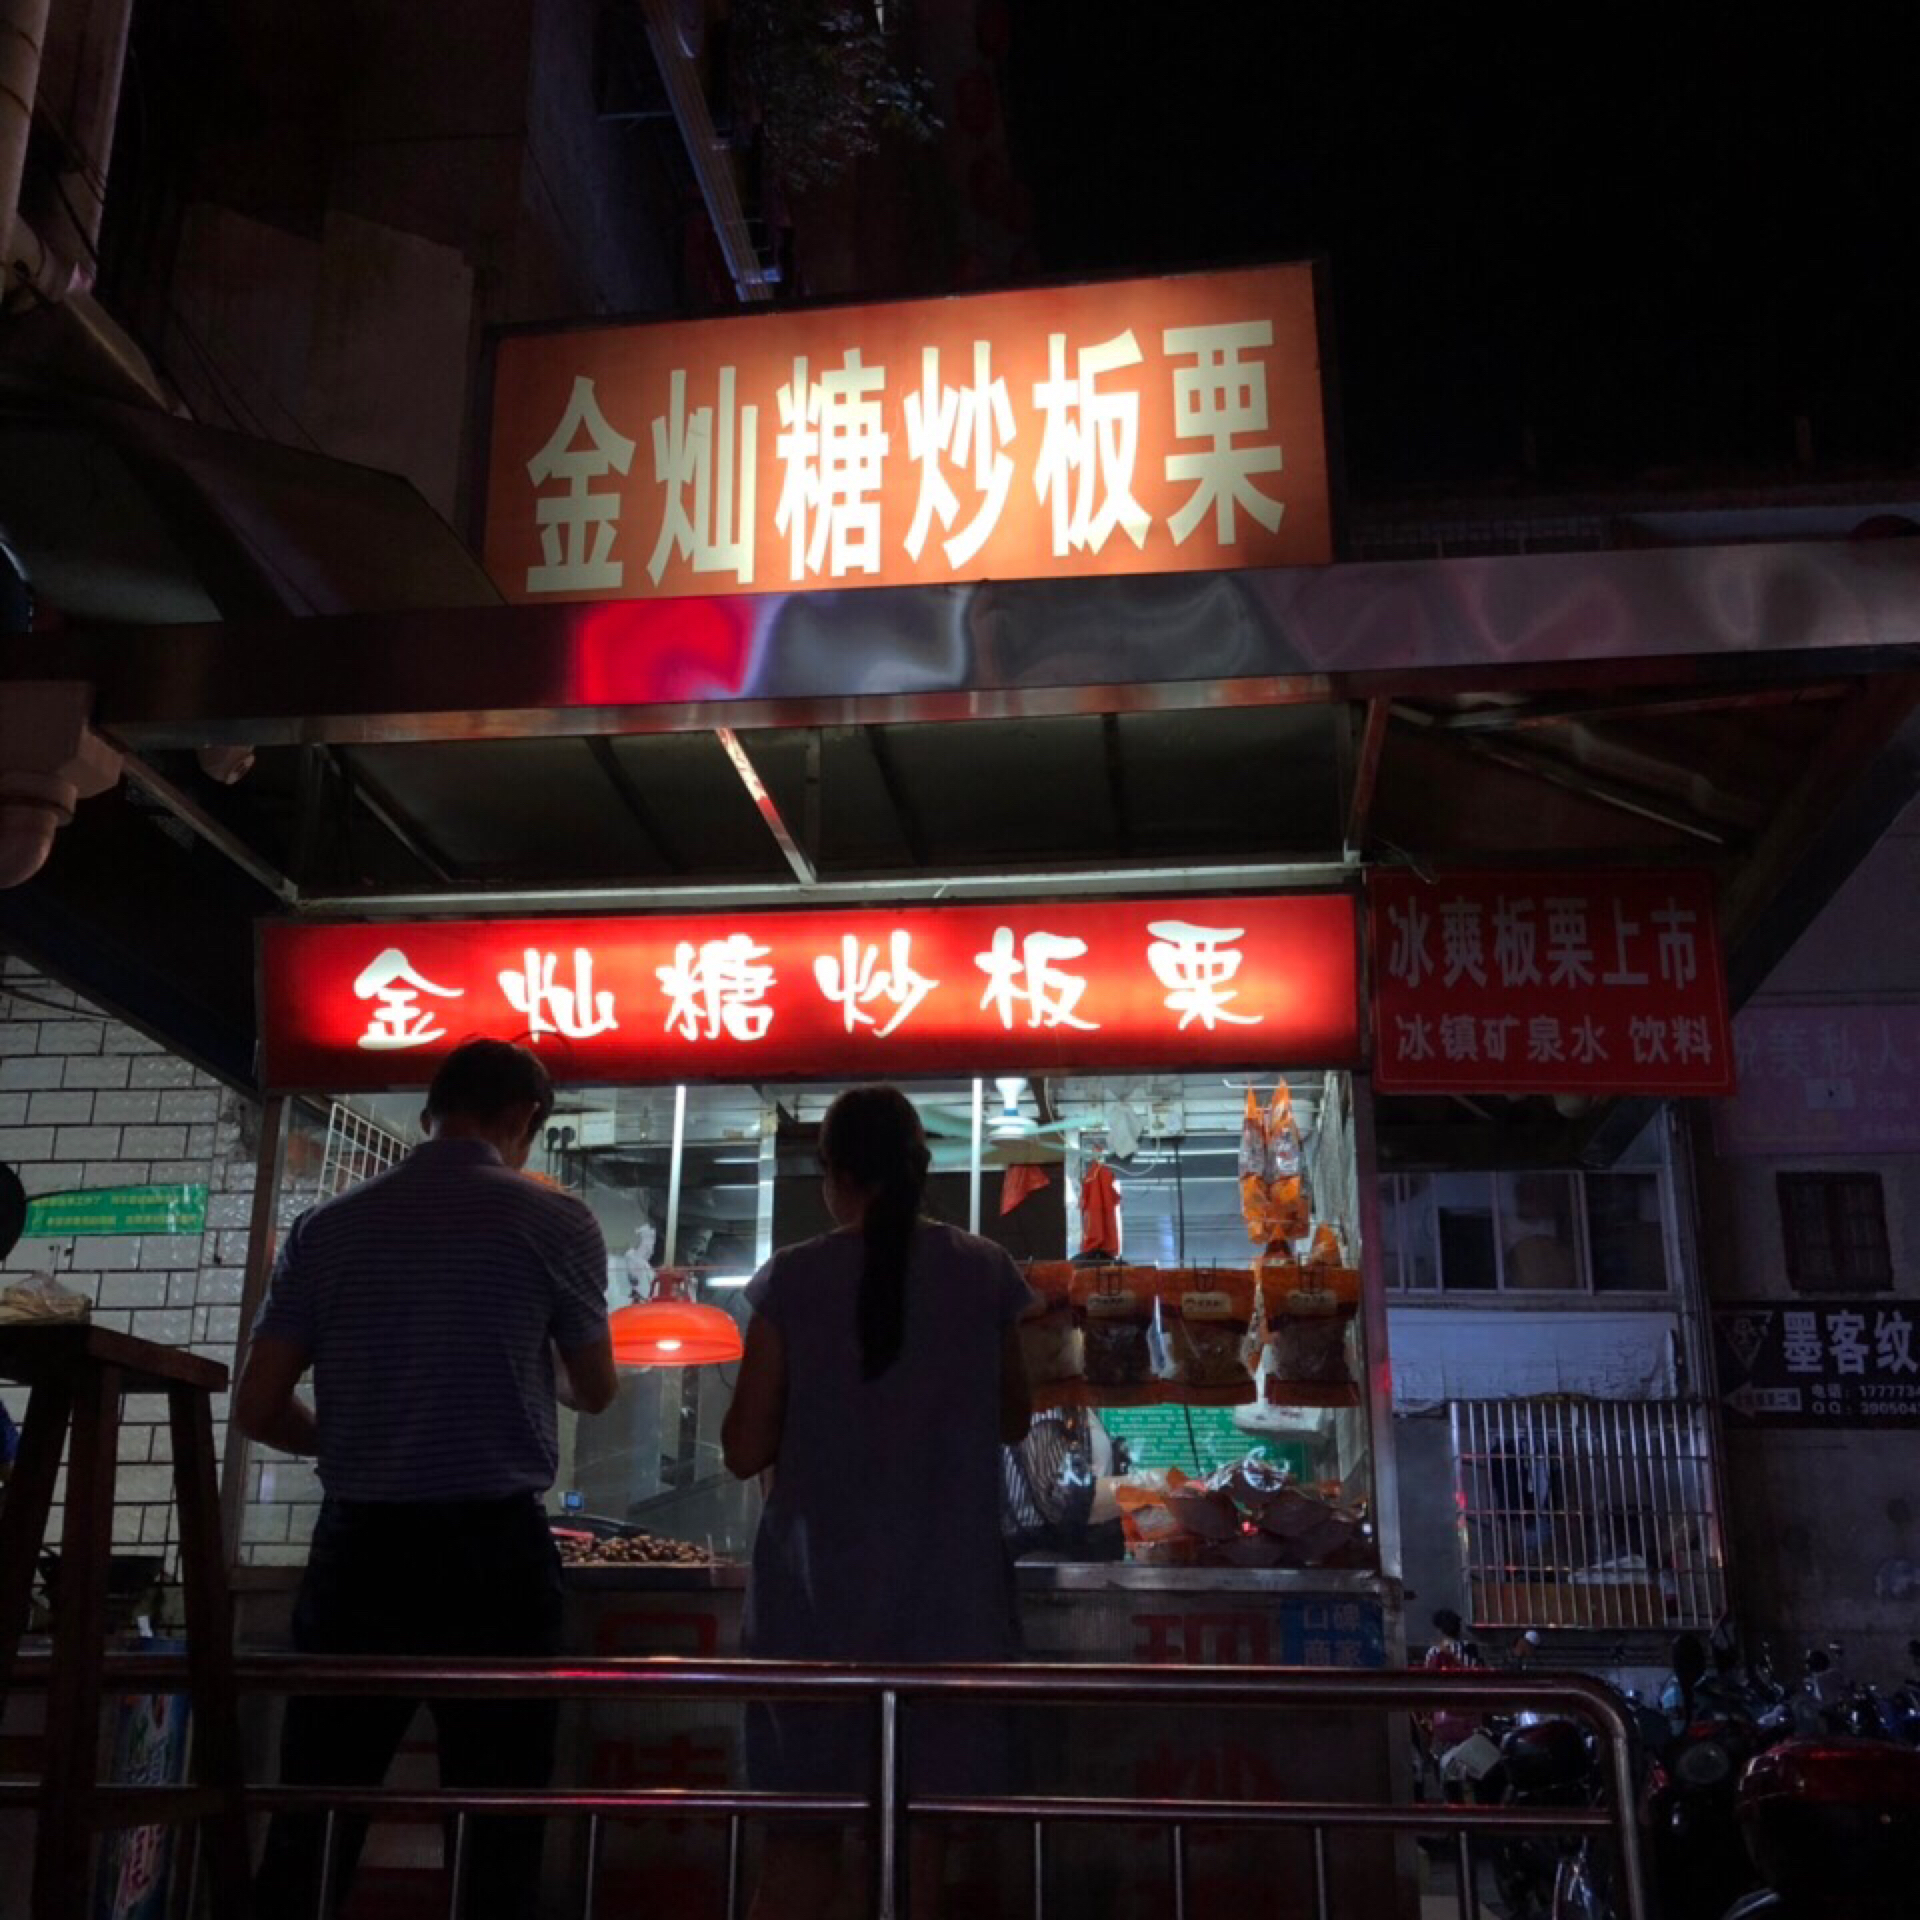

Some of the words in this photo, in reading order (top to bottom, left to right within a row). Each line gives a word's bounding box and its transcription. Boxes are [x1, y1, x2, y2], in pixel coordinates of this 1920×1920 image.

[526, 319, 1285, 594] 金灿糖炒板栗
[353, 918, 1264, 1051] 金灿糖炒板栗
[1387, 895, 1698, 991] 冰爽板栗上市
[1396, 1013, 1609, 1066] 冰镇矿泉水
[1628, 1014, 1713, 1066] 饮料
[1782, 1307, 1919, 1376] 墨客纹
